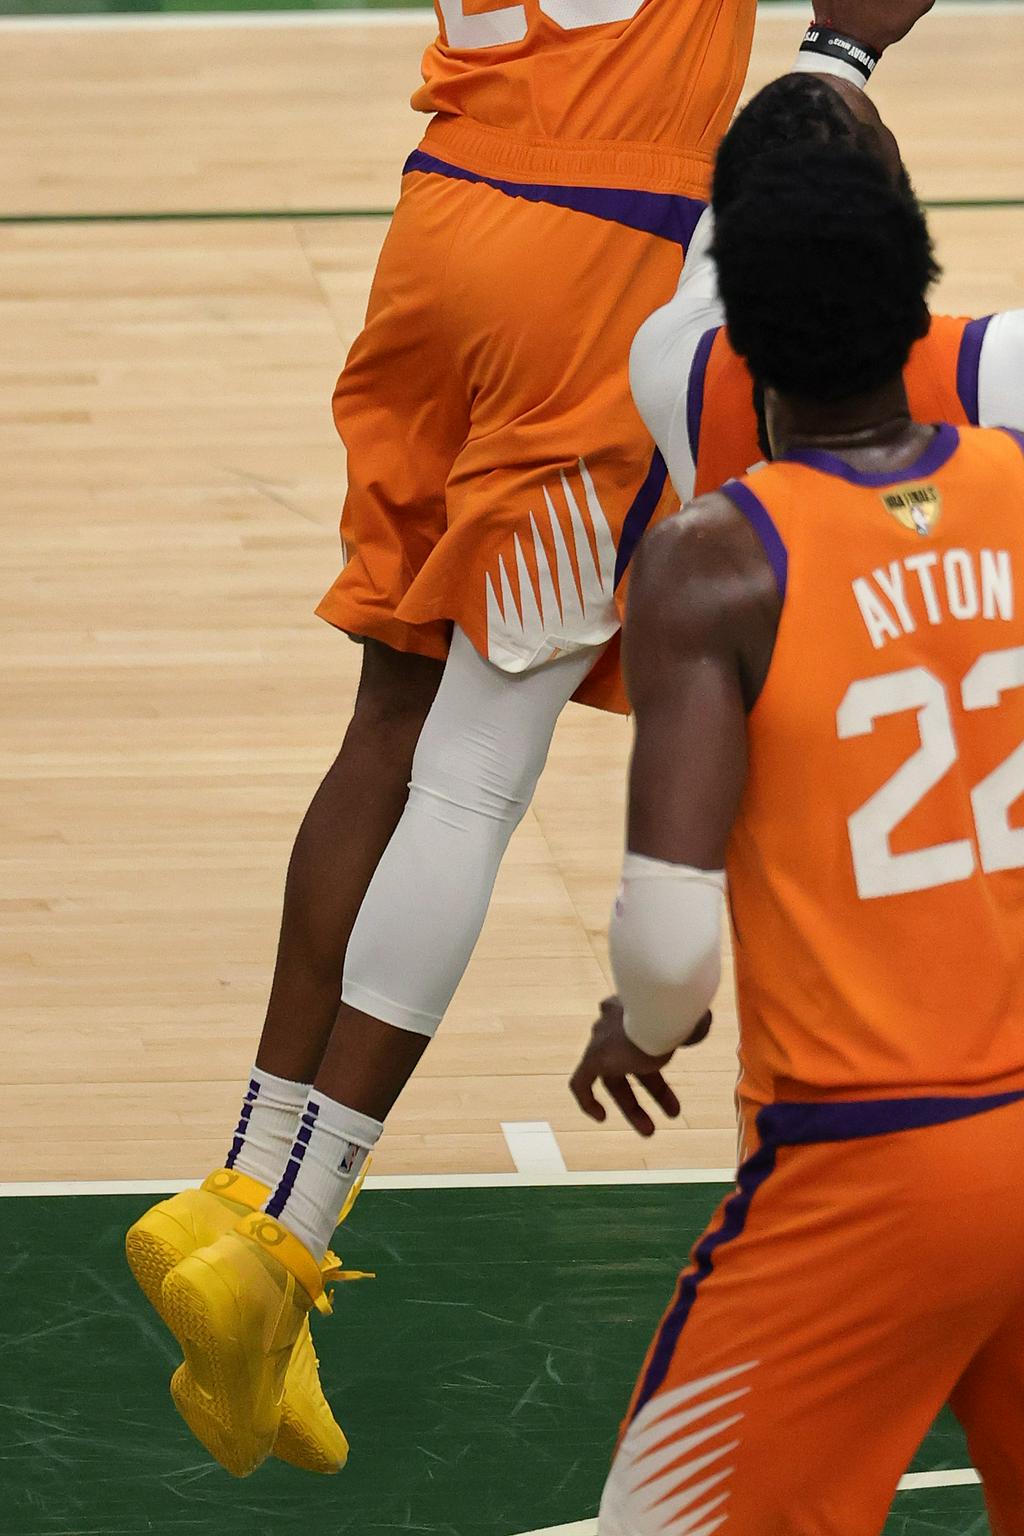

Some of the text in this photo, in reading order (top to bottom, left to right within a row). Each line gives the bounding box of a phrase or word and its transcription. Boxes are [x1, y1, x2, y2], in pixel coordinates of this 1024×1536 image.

[848, 46, 871, 66] PRAY
[885, 486, 937, 508] NBA FINALS
[851, 548, 1014, 650] AYTON
